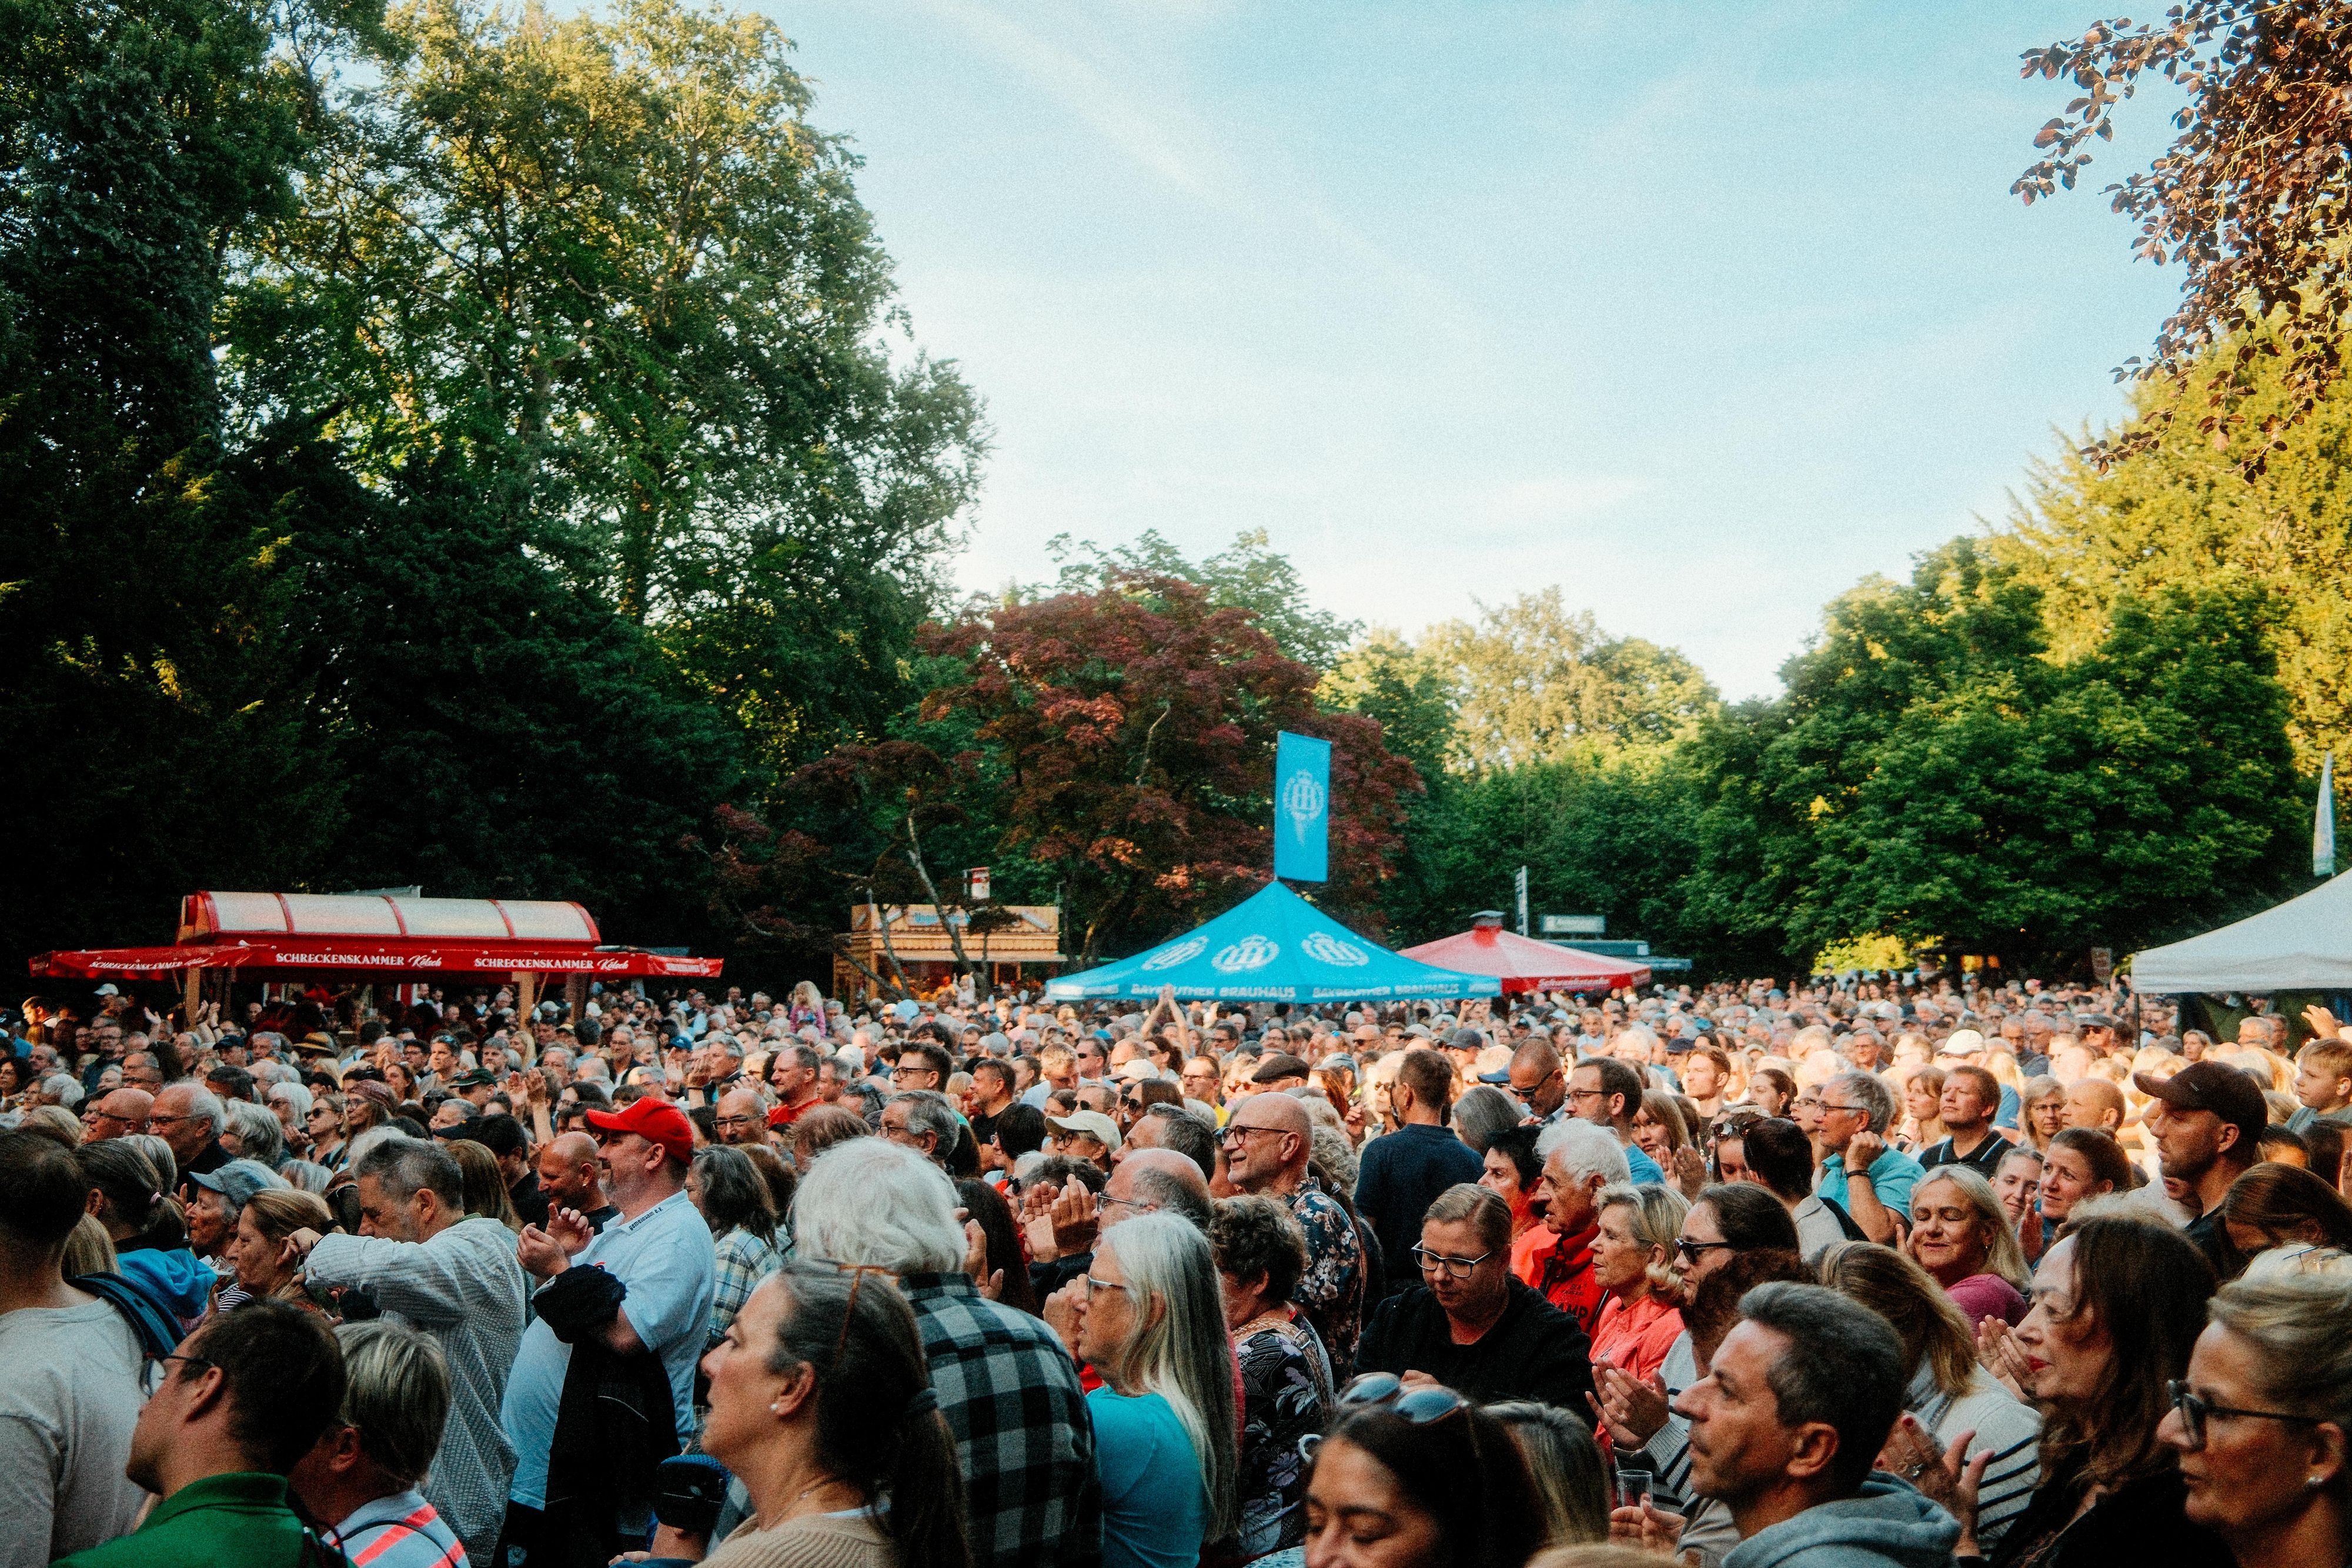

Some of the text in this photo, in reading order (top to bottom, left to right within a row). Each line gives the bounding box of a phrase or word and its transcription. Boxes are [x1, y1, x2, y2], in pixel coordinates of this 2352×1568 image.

[276, 952, 405, 965] SCHRECKENSKAMMER
[475, 958, 594, 969] SCHRECKENSKAMMER
[1219, 986, 1295, 998] BRAUHAUS
[629, 1211, 654, 1231] gemeinsam
